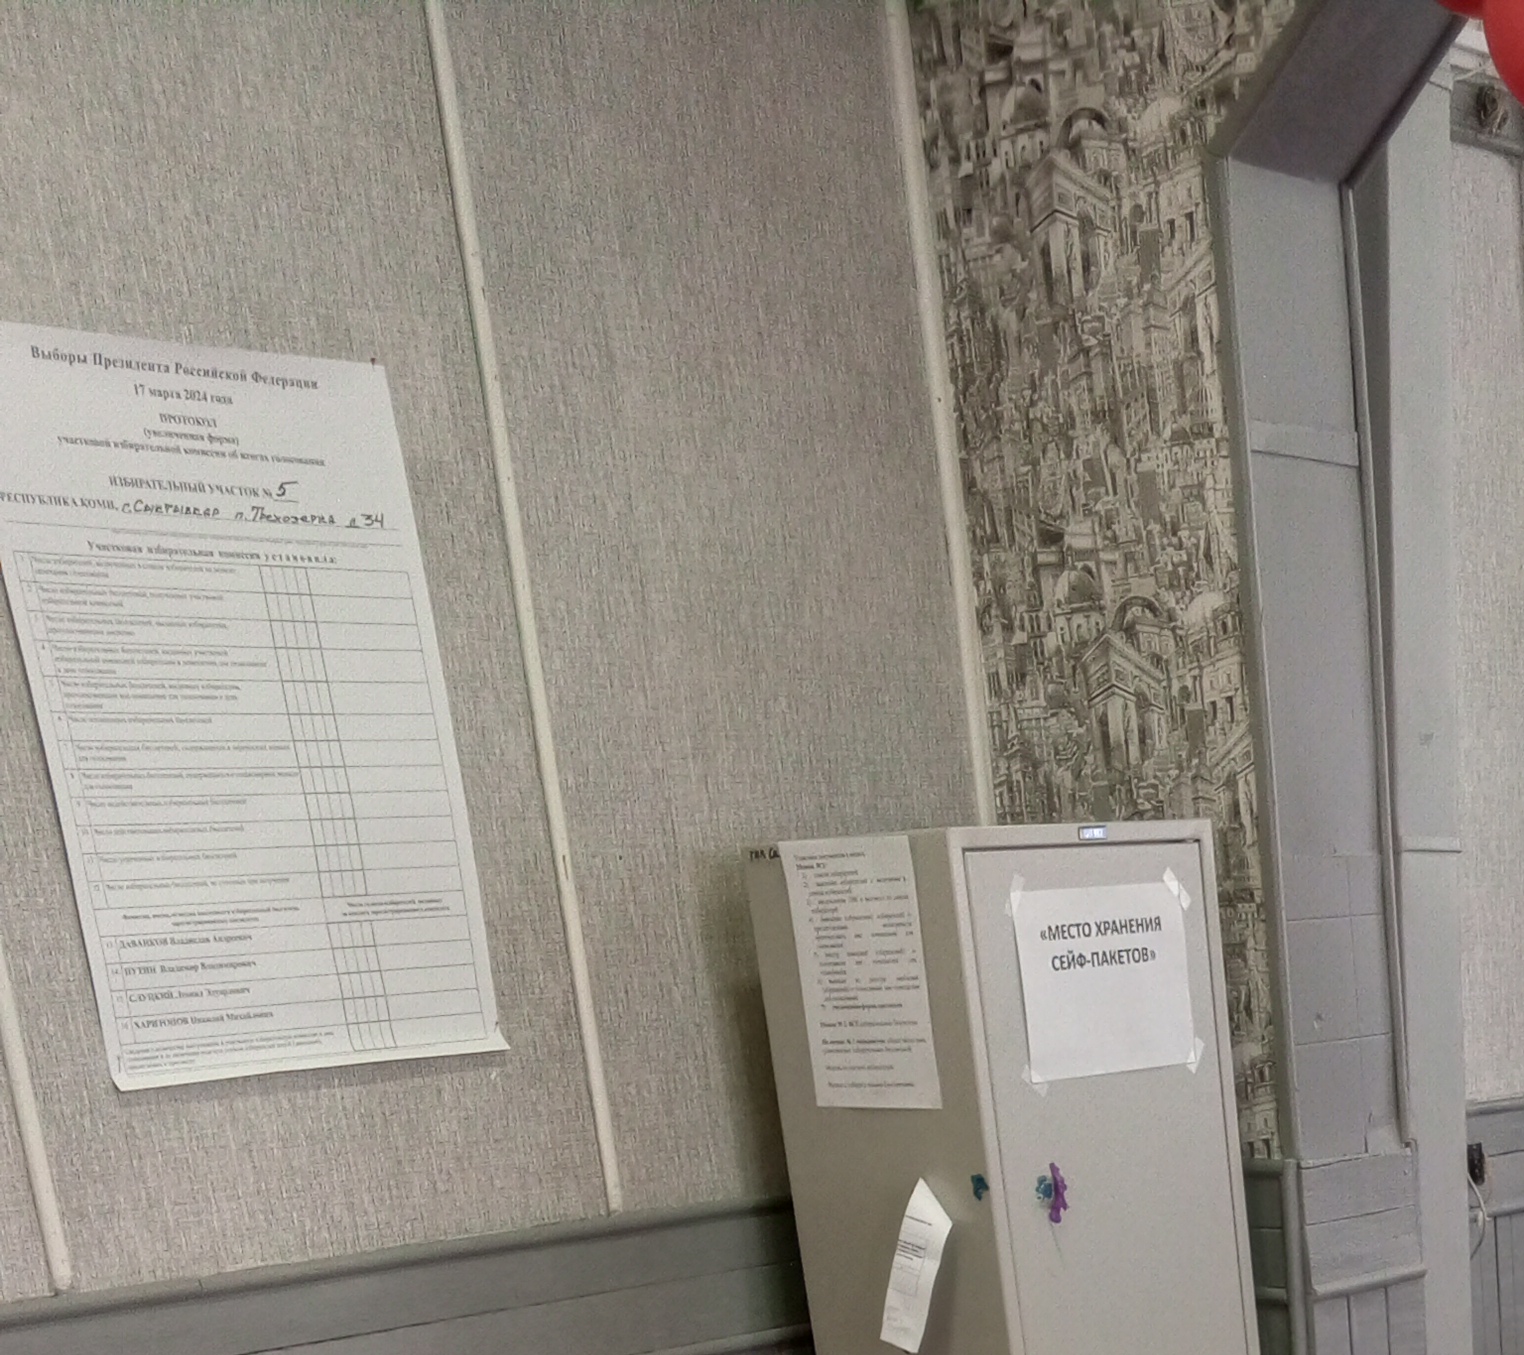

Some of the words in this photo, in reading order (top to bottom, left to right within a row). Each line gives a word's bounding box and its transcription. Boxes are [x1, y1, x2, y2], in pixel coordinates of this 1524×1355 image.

[30, 345, 87, 366] Выборы
[133, 383, 145, 397] 17
[276, 481, 299, 497] 5
[1040, 921, 1091, 941] «МЕСТО
[1094, 916, 1162, 937] ХРАНЕНИЯ
[1051, 947, 1156, 971] СЕЙФ-ПАКЕТОВ»
